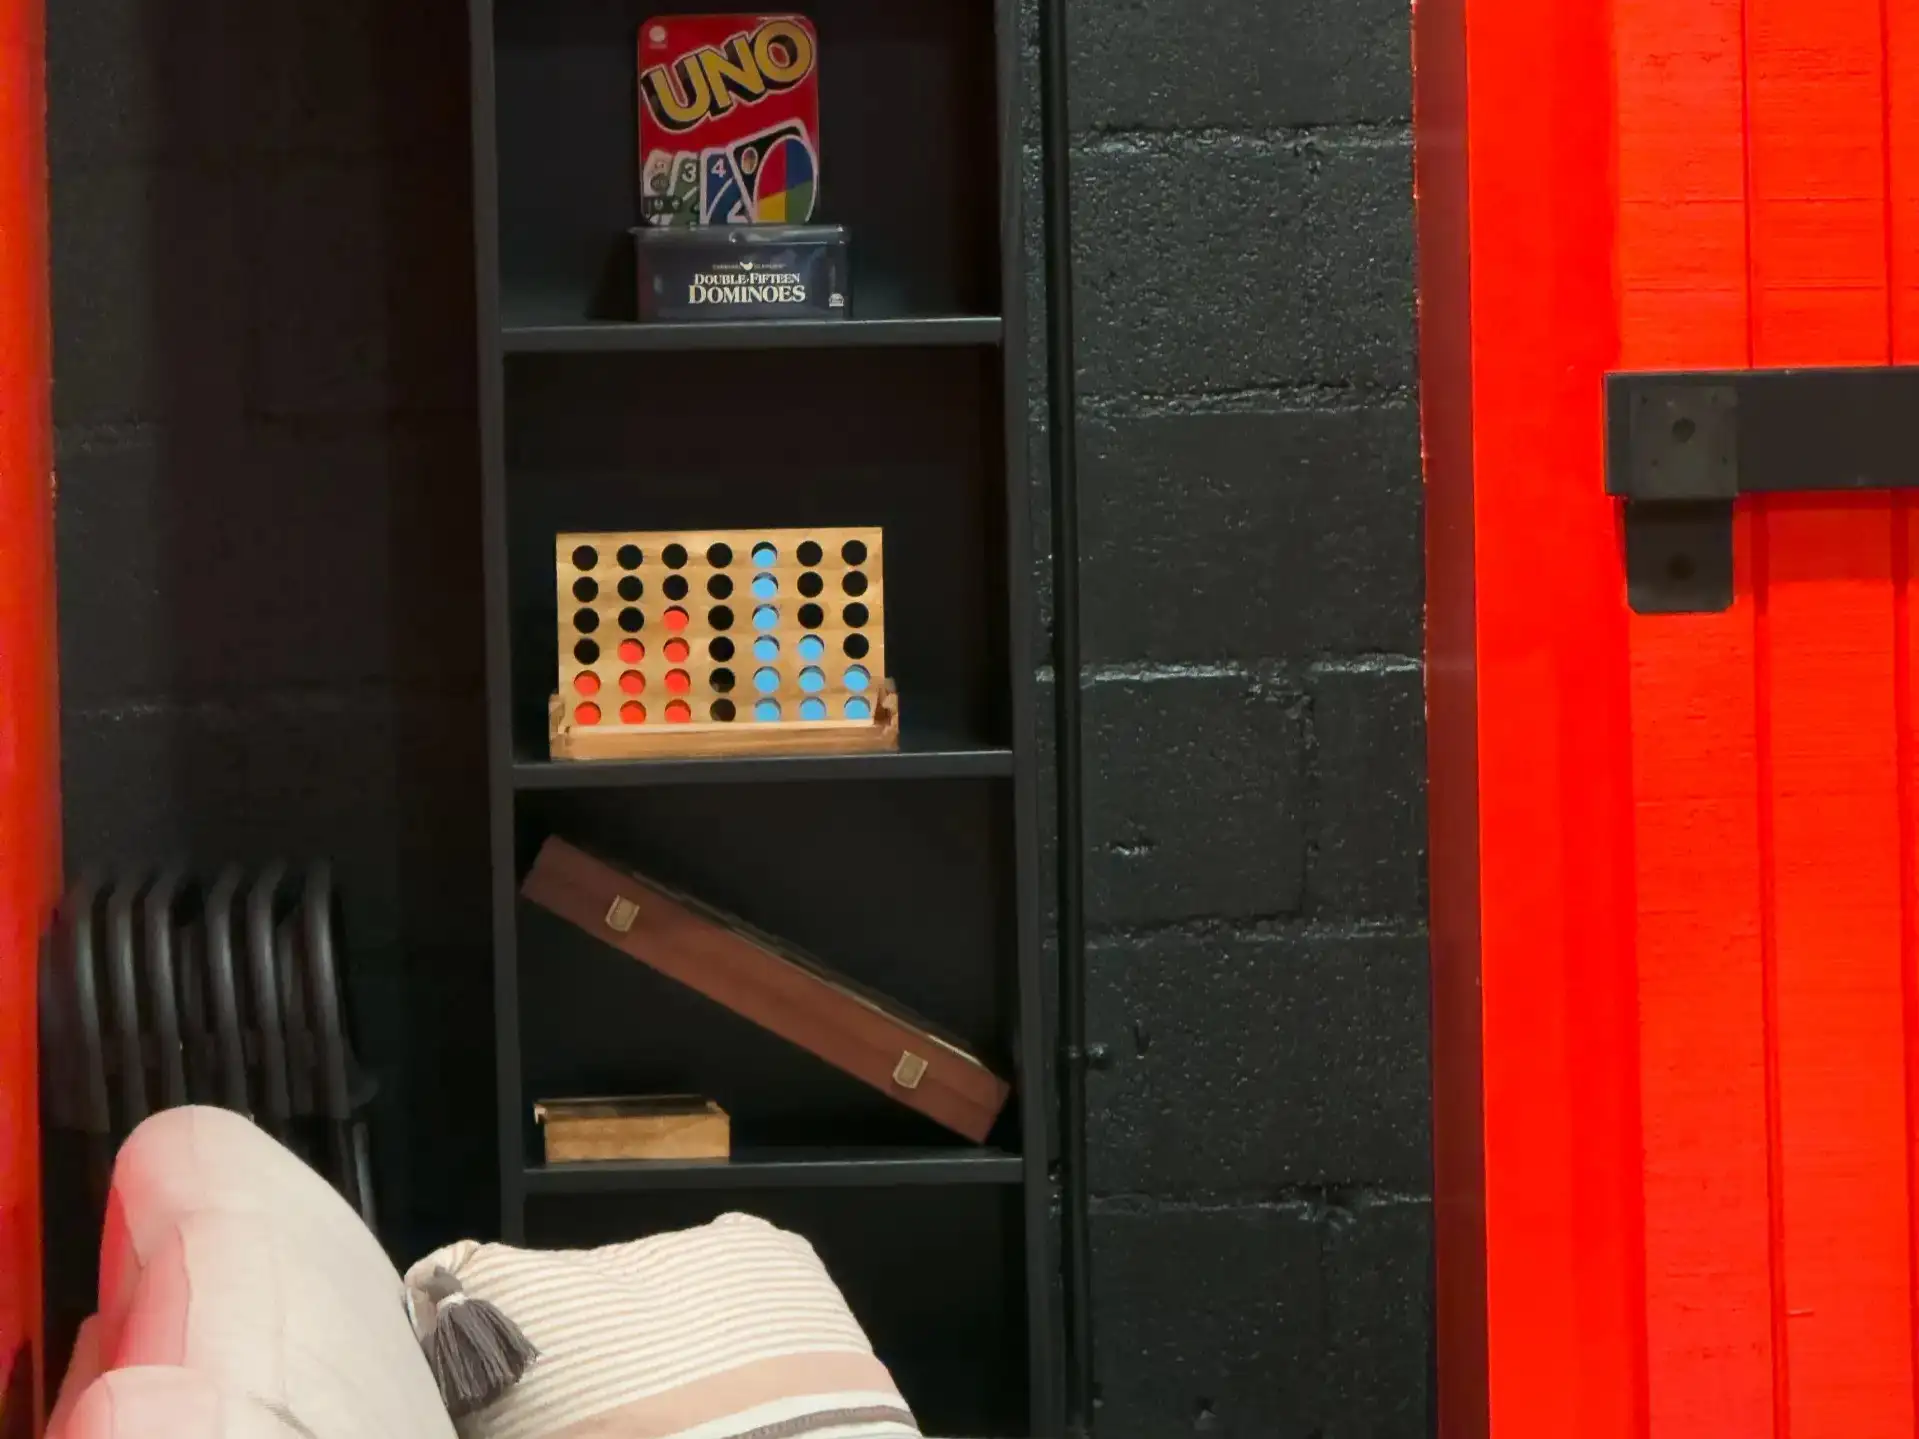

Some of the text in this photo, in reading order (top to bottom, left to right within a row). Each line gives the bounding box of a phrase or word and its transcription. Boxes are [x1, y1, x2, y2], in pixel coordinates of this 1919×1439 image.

[642, 20, 813, 130] UNO
[682, 163, 697, 182] 3
[711, 158, 726, 178] 4
[688, 285, 806, 304] DOMINOES
